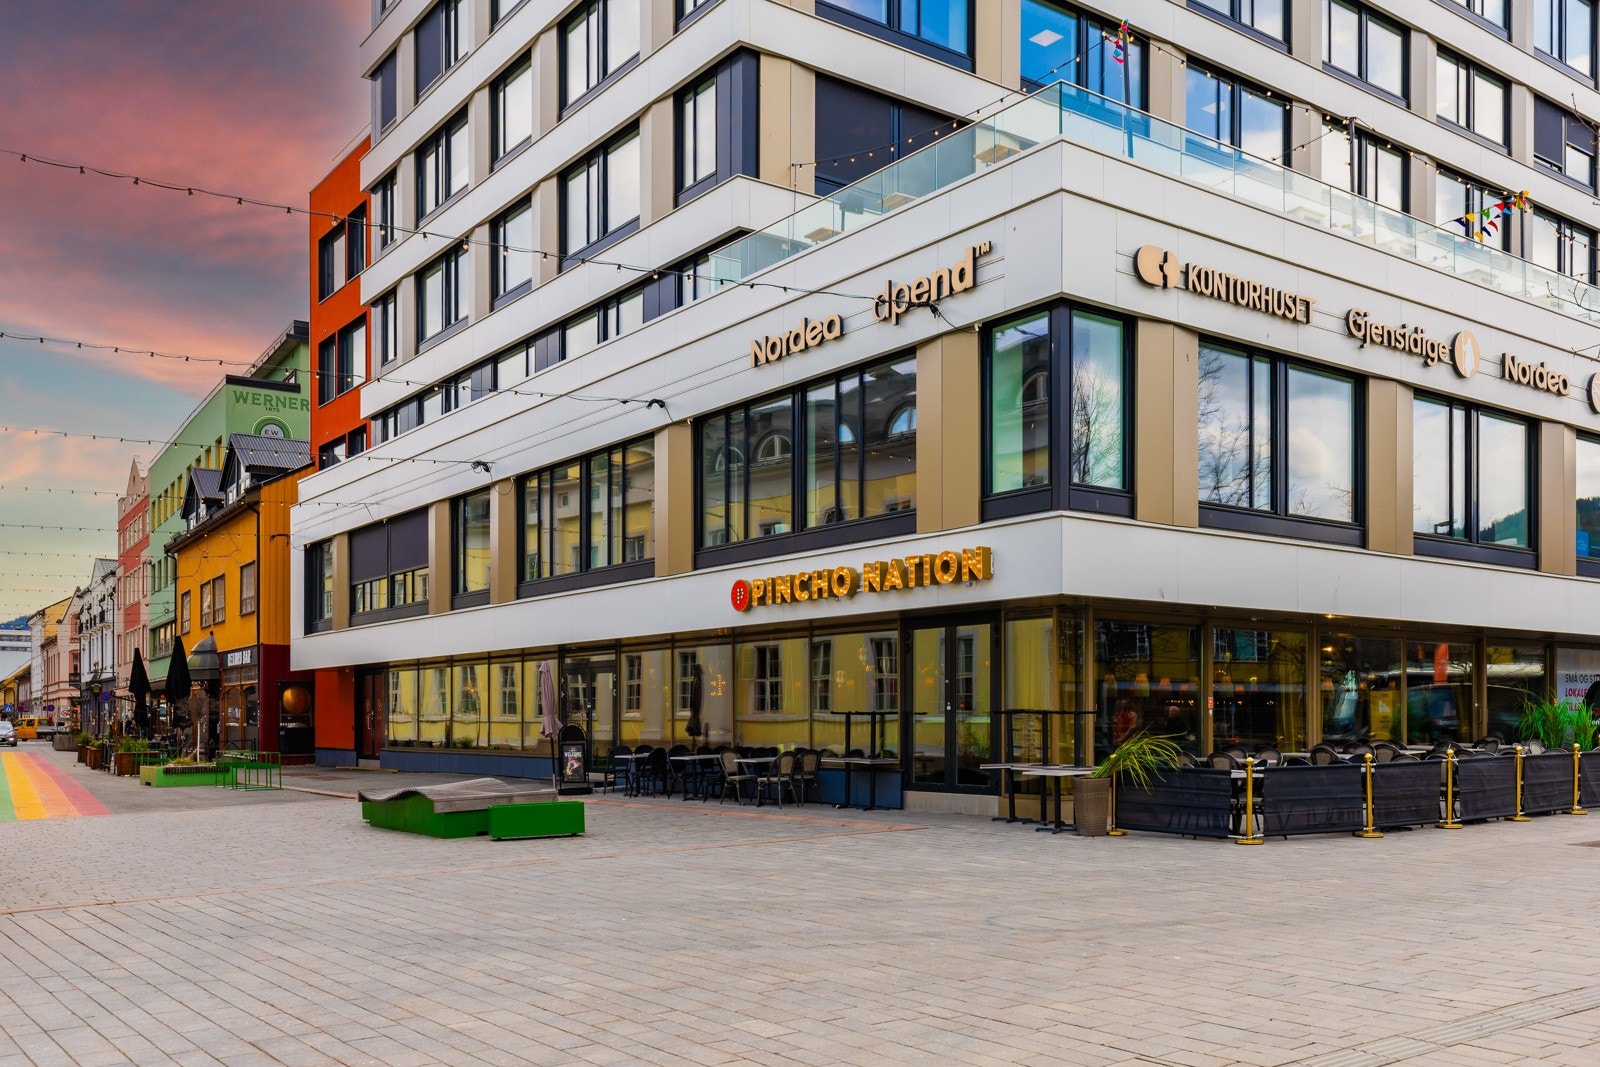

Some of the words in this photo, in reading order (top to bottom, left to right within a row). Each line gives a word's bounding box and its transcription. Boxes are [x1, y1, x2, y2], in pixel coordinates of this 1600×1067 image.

[1186, 262, 1316, 325] KONTORHUSET
[750, 313, 843, 367] Nordea
[1346, 306, 1453, 368] Gjensidige
[233, 390, 309, 411] WERNER
[1502, 352, 1571, 396] Nordea
[751, 566, 854, 607] PINCHO
[863, 546, 986, 593] NATION
[1565, 669, 1577, 683] SMÅ
[1578, 674, 1589, 683] OG
